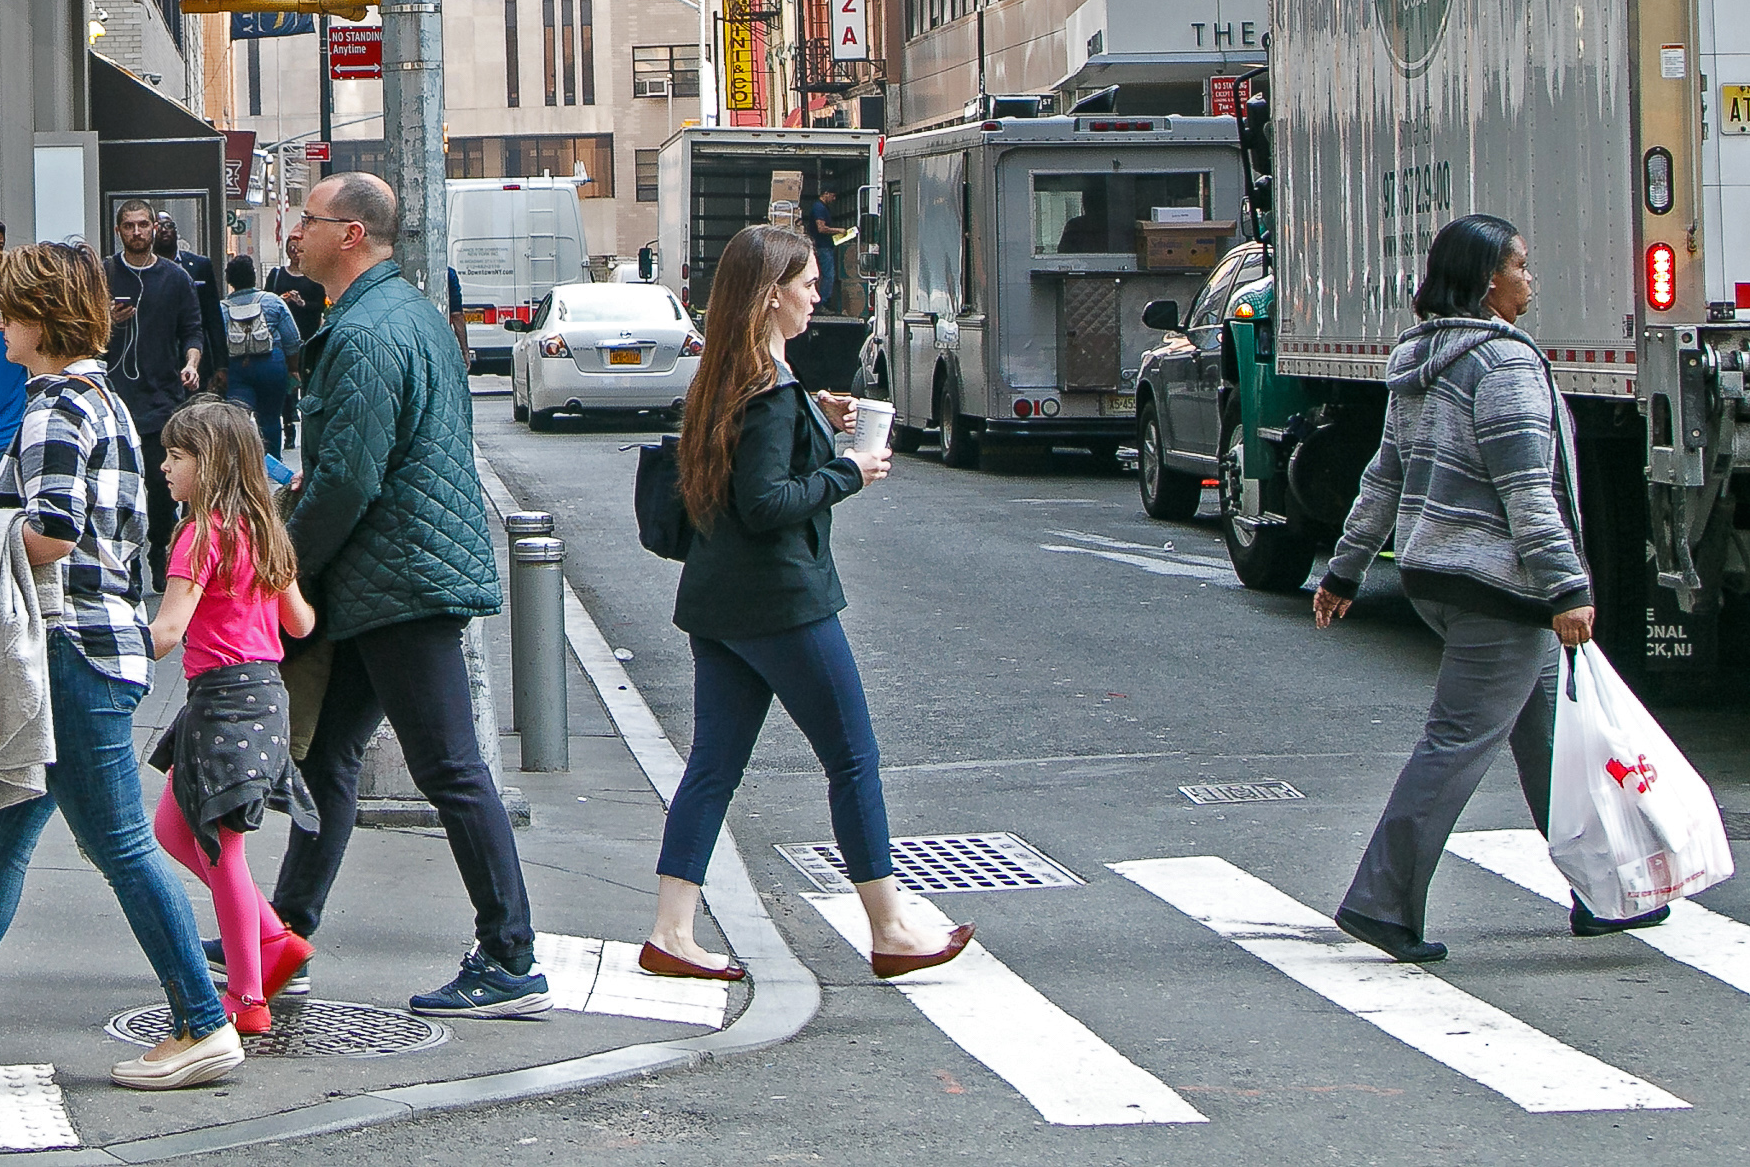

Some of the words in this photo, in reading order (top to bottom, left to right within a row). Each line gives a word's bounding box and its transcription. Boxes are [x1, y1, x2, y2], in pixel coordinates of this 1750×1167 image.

[332, 31, 344, 42] NO
[1190, 21, 1255, 47] THE
[332, 43, 367, 56] Anytime
[1042, 98, 1052, 106] ST
[1383, 159, 1451, 219] 97.672.900
[1674, 642, 1693, 657] NJ
